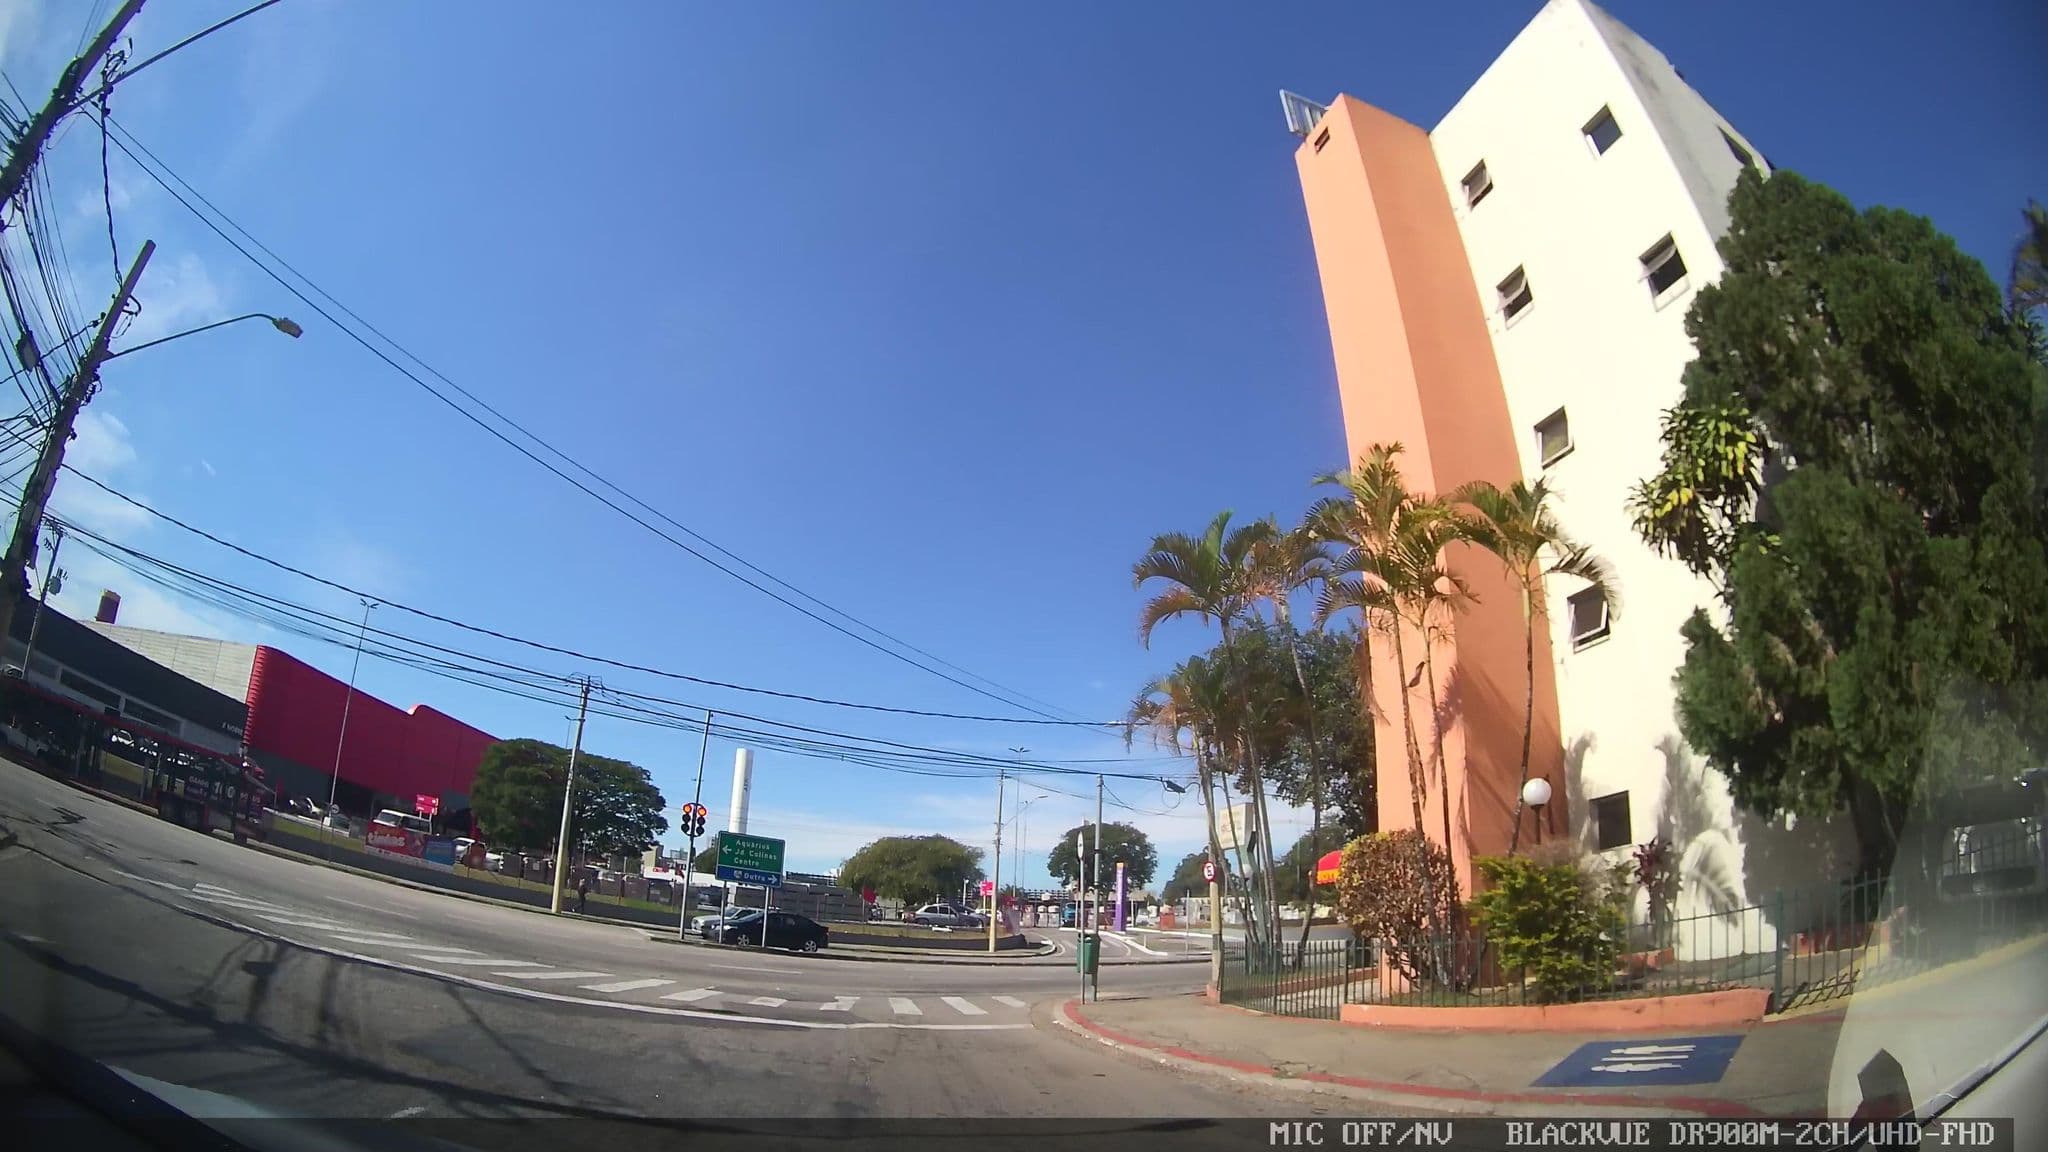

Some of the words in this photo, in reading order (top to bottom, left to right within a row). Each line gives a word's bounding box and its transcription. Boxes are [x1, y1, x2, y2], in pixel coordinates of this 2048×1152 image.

[736, 839, 770, 850] Aquarius
[734, 857, 759, 866] Centro
[744, 872, 766, 881] Dutra
